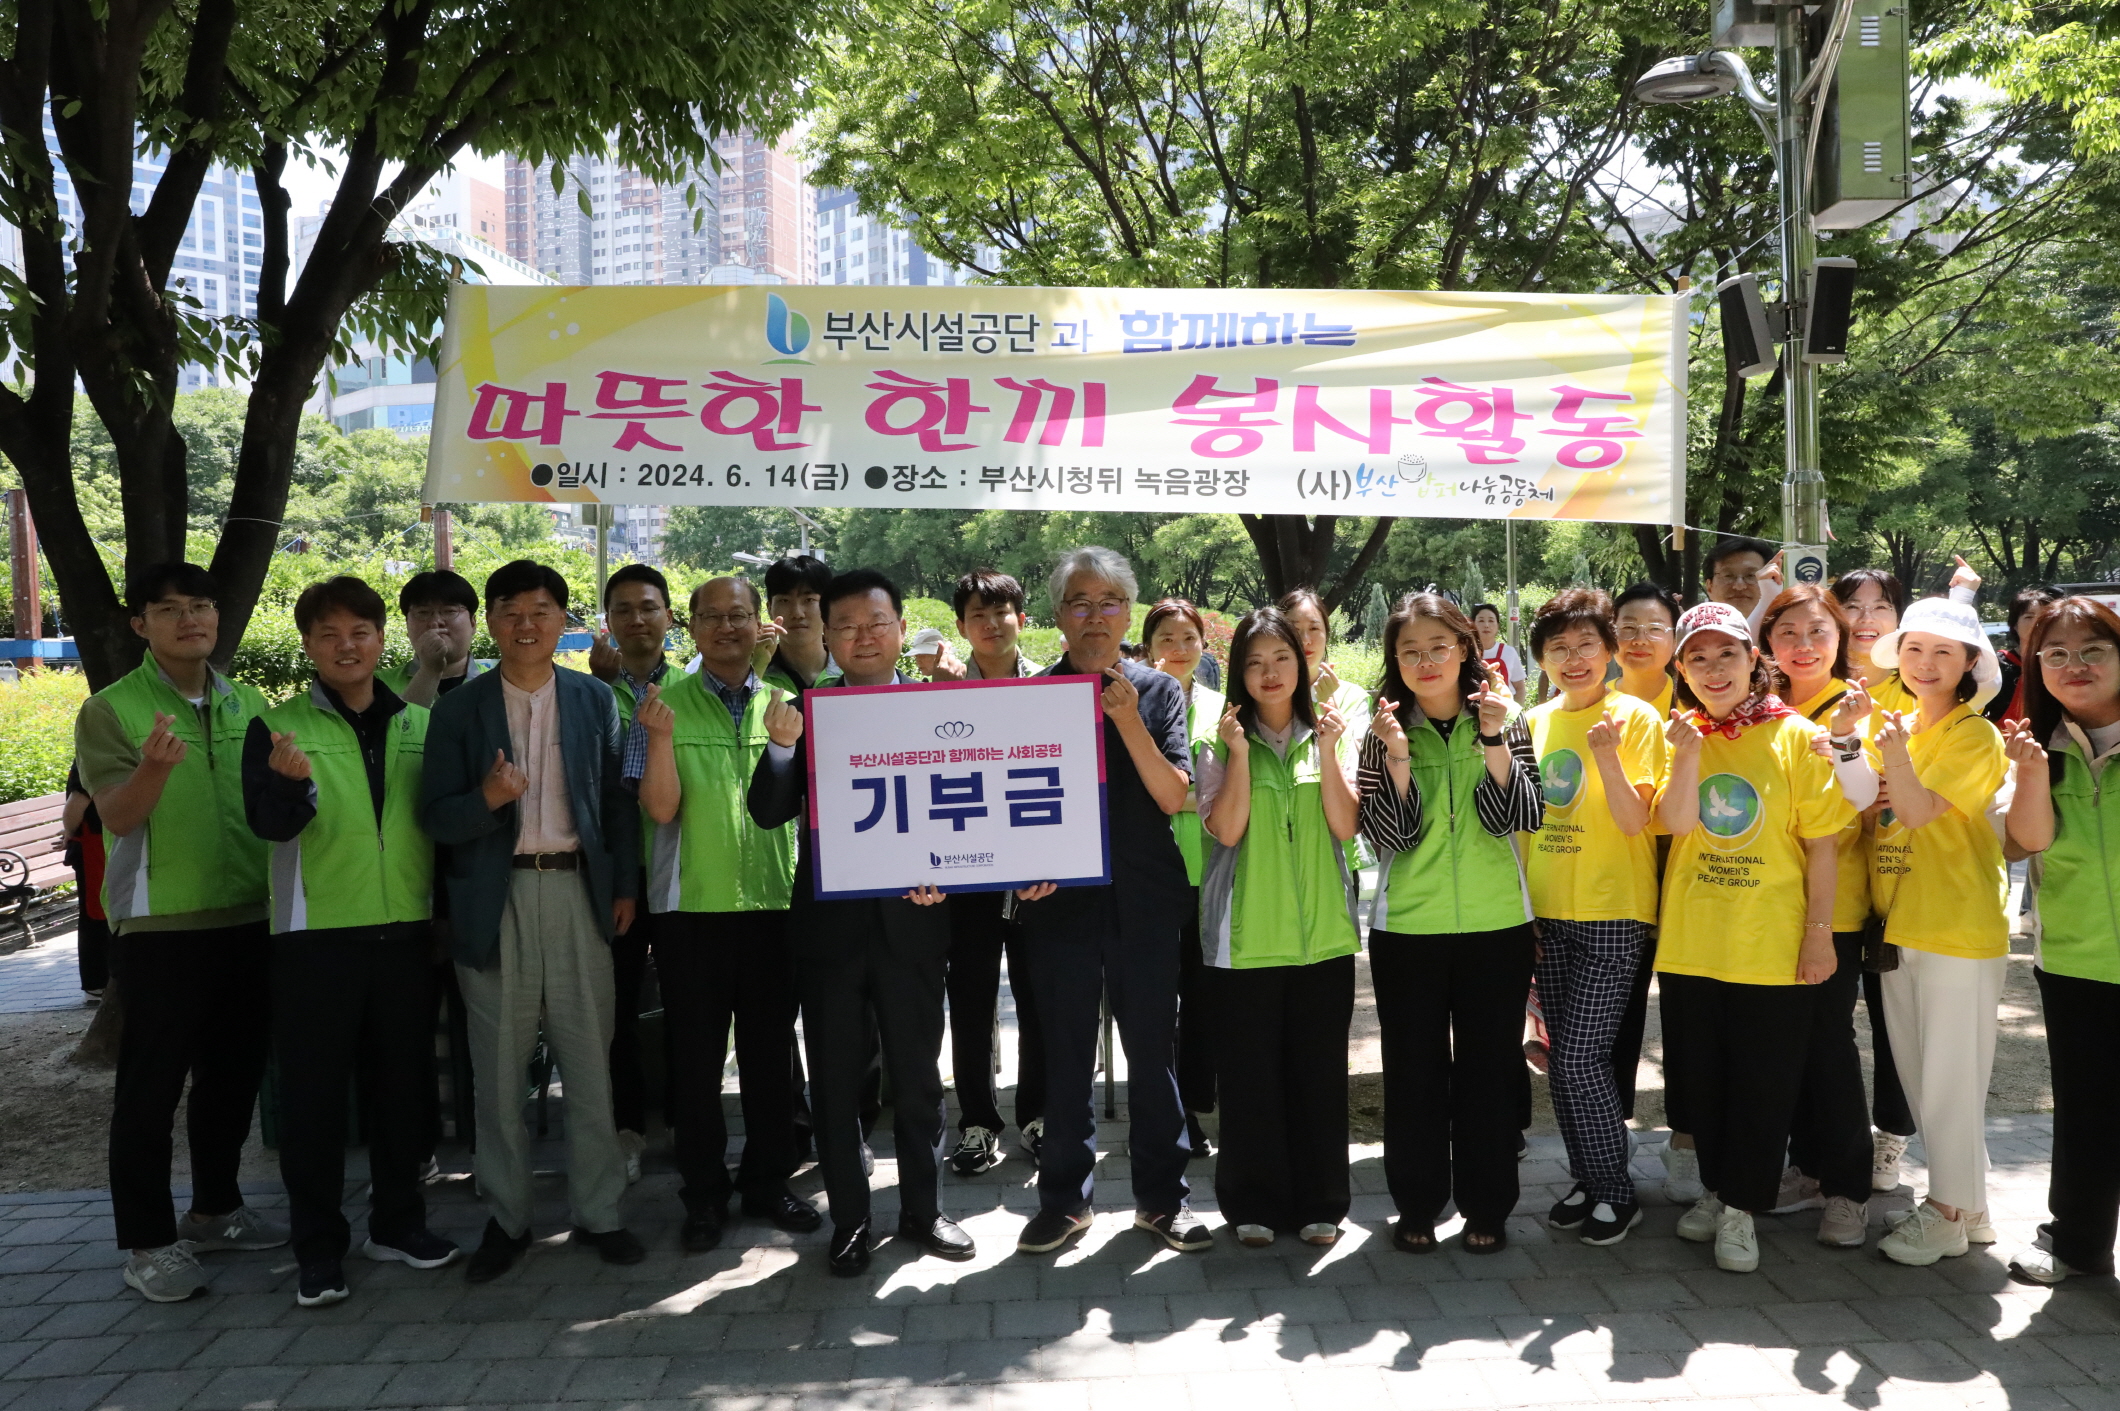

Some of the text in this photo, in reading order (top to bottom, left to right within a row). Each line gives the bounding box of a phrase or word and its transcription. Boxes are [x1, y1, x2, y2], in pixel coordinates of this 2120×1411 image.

[822, 309, 1356, 354] 부산시설공단 과 함께하는
[468, 370, 822, 452] 따뜻한
[1168, 373, 1643, 469] 봉사활동
[637, 463, 714, 487] 2024.
[726, 464, 750, 487] 6.
[764, 462, 850, 491] 14(금)
[978, 465, 1123, 495] 부산시청뒤
[1134, 467, 1251, 497] 녹음광장
[850, 743, 1062, 768] 부산시설공단과 함께하는 사회공헌
[852, 767, 1065, 834] 기부금
[1540, 823, 1585, 833] NTERNATIONAL
[944, 852, 994, 865] 부산시설공단
[1697, 852, 1766, 865] INTERNATIONAL
[1708, 864, 1750, 876] WOMEN'S
[1697, 873, 1761, 888] PEACE GROUP
